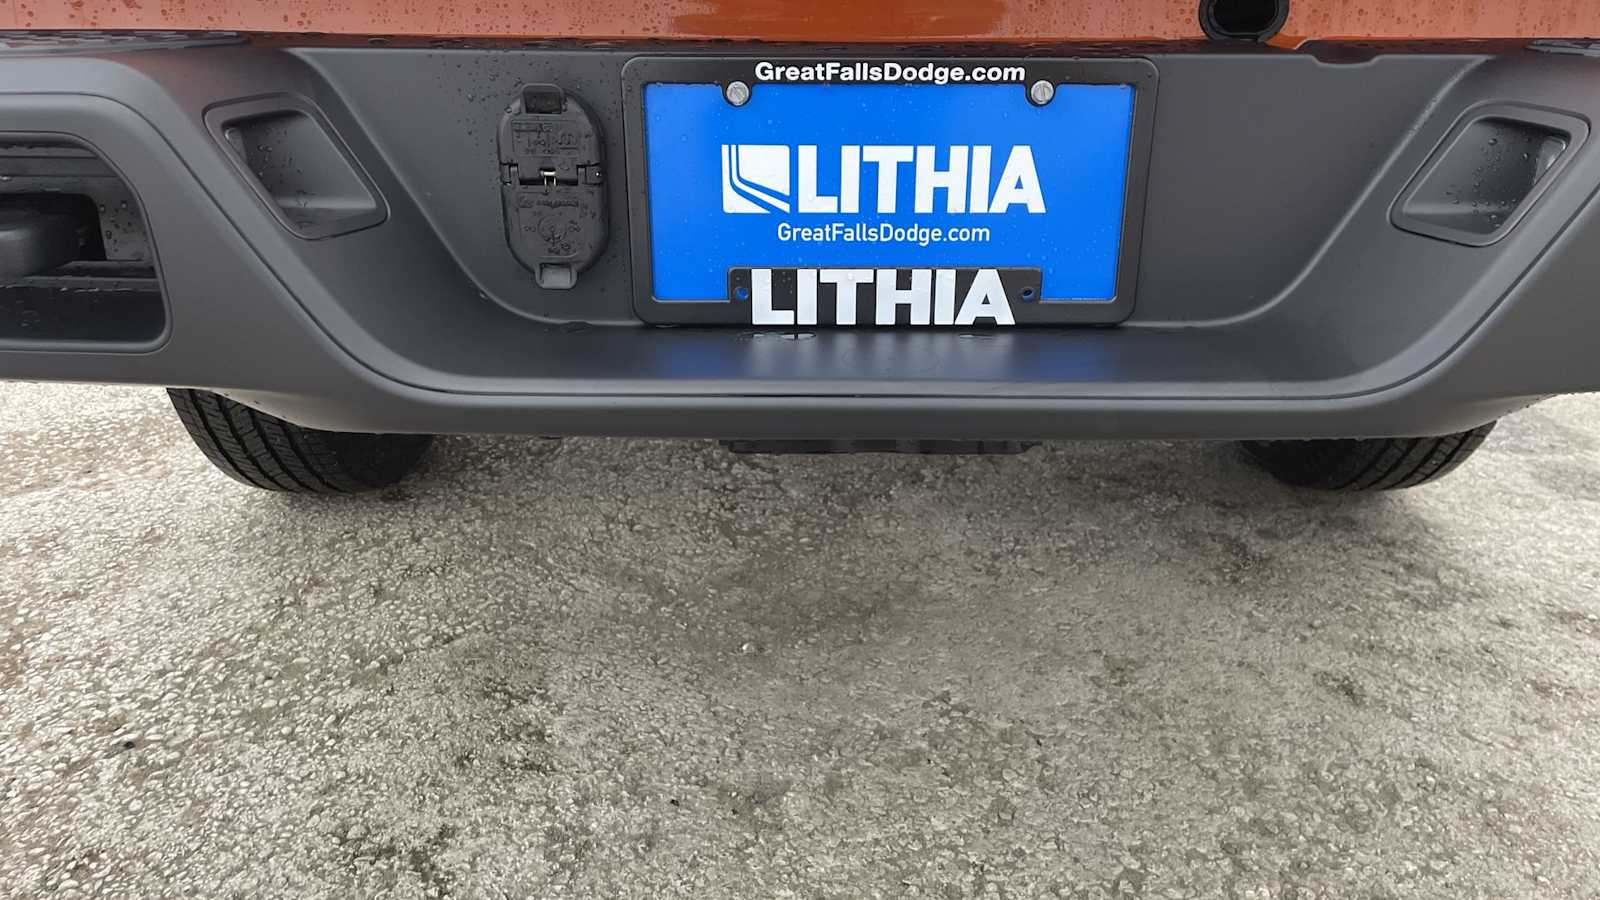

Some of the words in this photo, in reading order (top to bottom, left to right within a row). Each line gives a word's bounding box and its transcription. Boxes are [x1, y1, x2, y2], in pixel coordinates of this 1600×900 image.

[754, 61, 1026, 84] GreatFallsDodge.com
[797, 144, 1046, 213] LITHIA
[777, 223, 990, 247] GreatFallsDodge.com
[751, 268, 1015, 325] LITHIA
